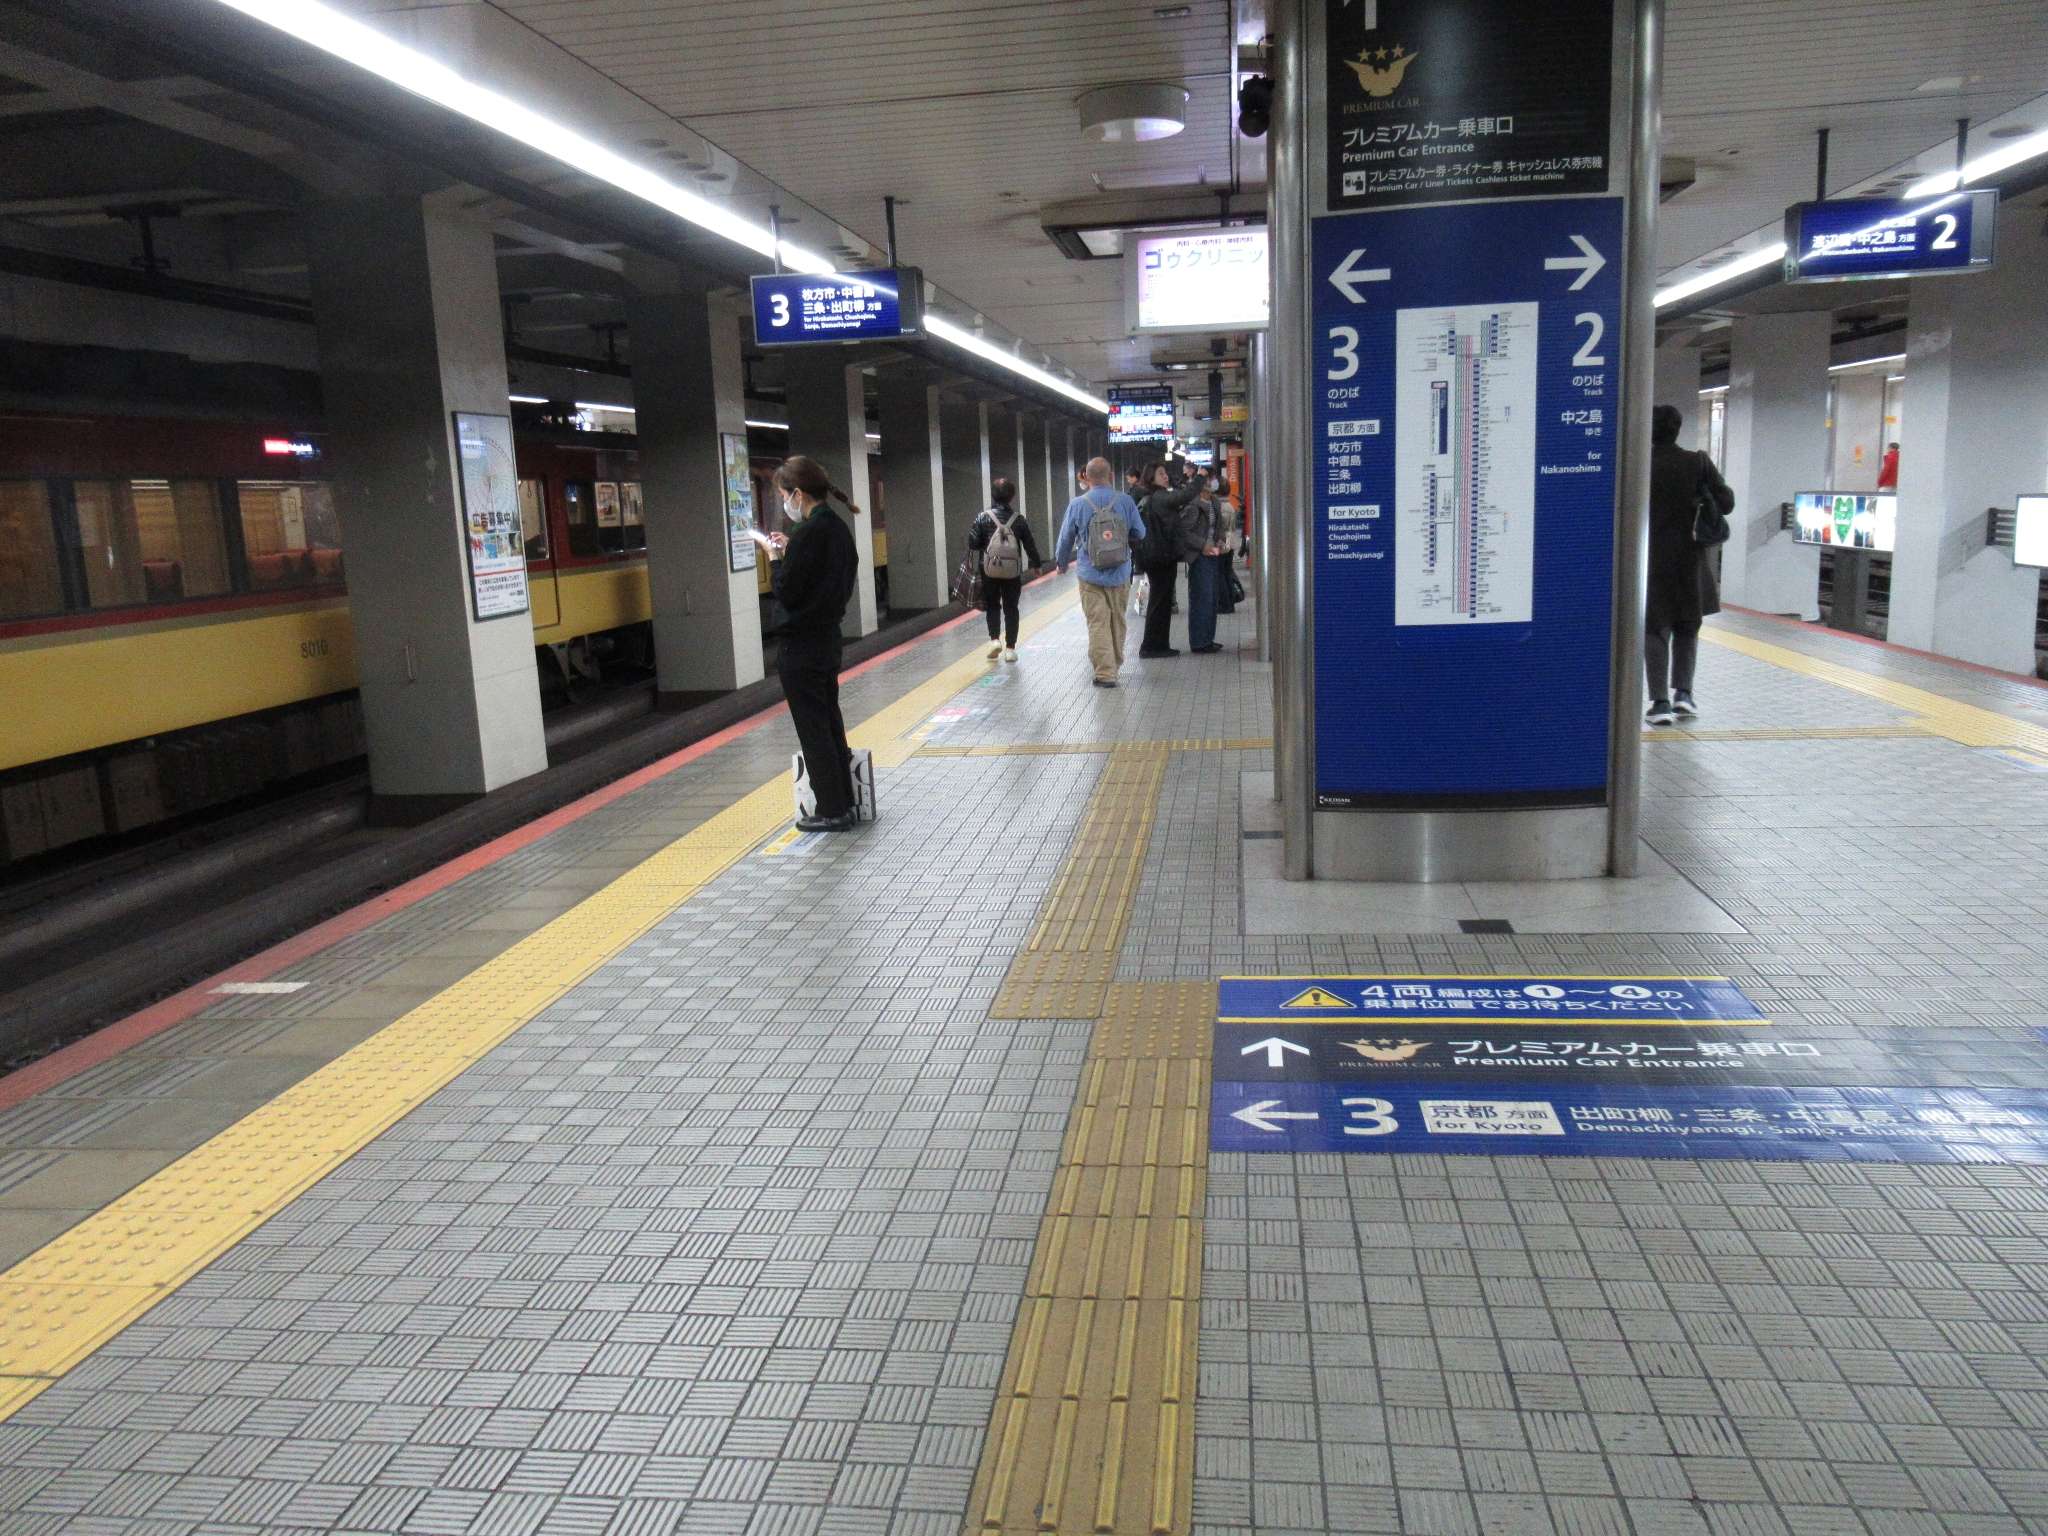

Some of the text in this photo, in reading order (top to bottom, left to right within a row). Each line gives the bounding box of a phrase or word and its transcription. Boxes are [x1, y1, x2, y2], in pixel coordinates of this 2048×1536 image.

[1342, 116, 1514, 148] プレミアムカー乗車口
[1342, 143, 1475, 163] Premium Car Entrance
[1369, 183, 1403, 193] Premium
[1405, 182, 1418, 190] Car
[1932, 213, 1958, 250] 2
[770, 294, 790, 327] 3
[1572, 311, 1605, 367] 2
[1327, 325, 1360, 381] 3
[1572, 374, 1604, 387] のりば
[1327, 386, 1360, 399] のりば
[1583, 388, 1603, 396] Track
[1328, 401, 1348, 409] Track
[1561, 409, 1603, 424] 中之島
[1332, 422, 1376, 435] 京都 方面
[1585, 427, 1602, 436] ゆき
[1328, 441, 1362, 454] 枚方市
[1328, 455, 1361, 467] 中書島
[1587, 451, 1601, 460] for
[1328, 469, 1351, 480] 三条
[1540, 465, 1601, 475] Nakanoshima
[1328, 482, 1362, 495] 出町柳
[1333, 507, 1376, 519] for Kyoto
[1328, 523, 1369, 532] Hirakatashi
[1328, 533, 1371, 542] Chushojima
[1328, 543, 1349, 552] Sanjo
[1328, 551, 1384, 561] Demachiyanagi
[1363, 999, 1695, 1011] 乗車位置でお待ちください
[1448, 1040, 1822, 1057] プレミアムカー乗車口
[1339, 1060, 1406, 1068] PREMIUM
[1454, 1056, 1744, 1068] Premium Car Entrance
[1342, 1097, 1399, 1135] 3
[1430, 1104, 1548, 1120] 京都 方面
[1436, 1120, 1543, 1132] for Kyoto
